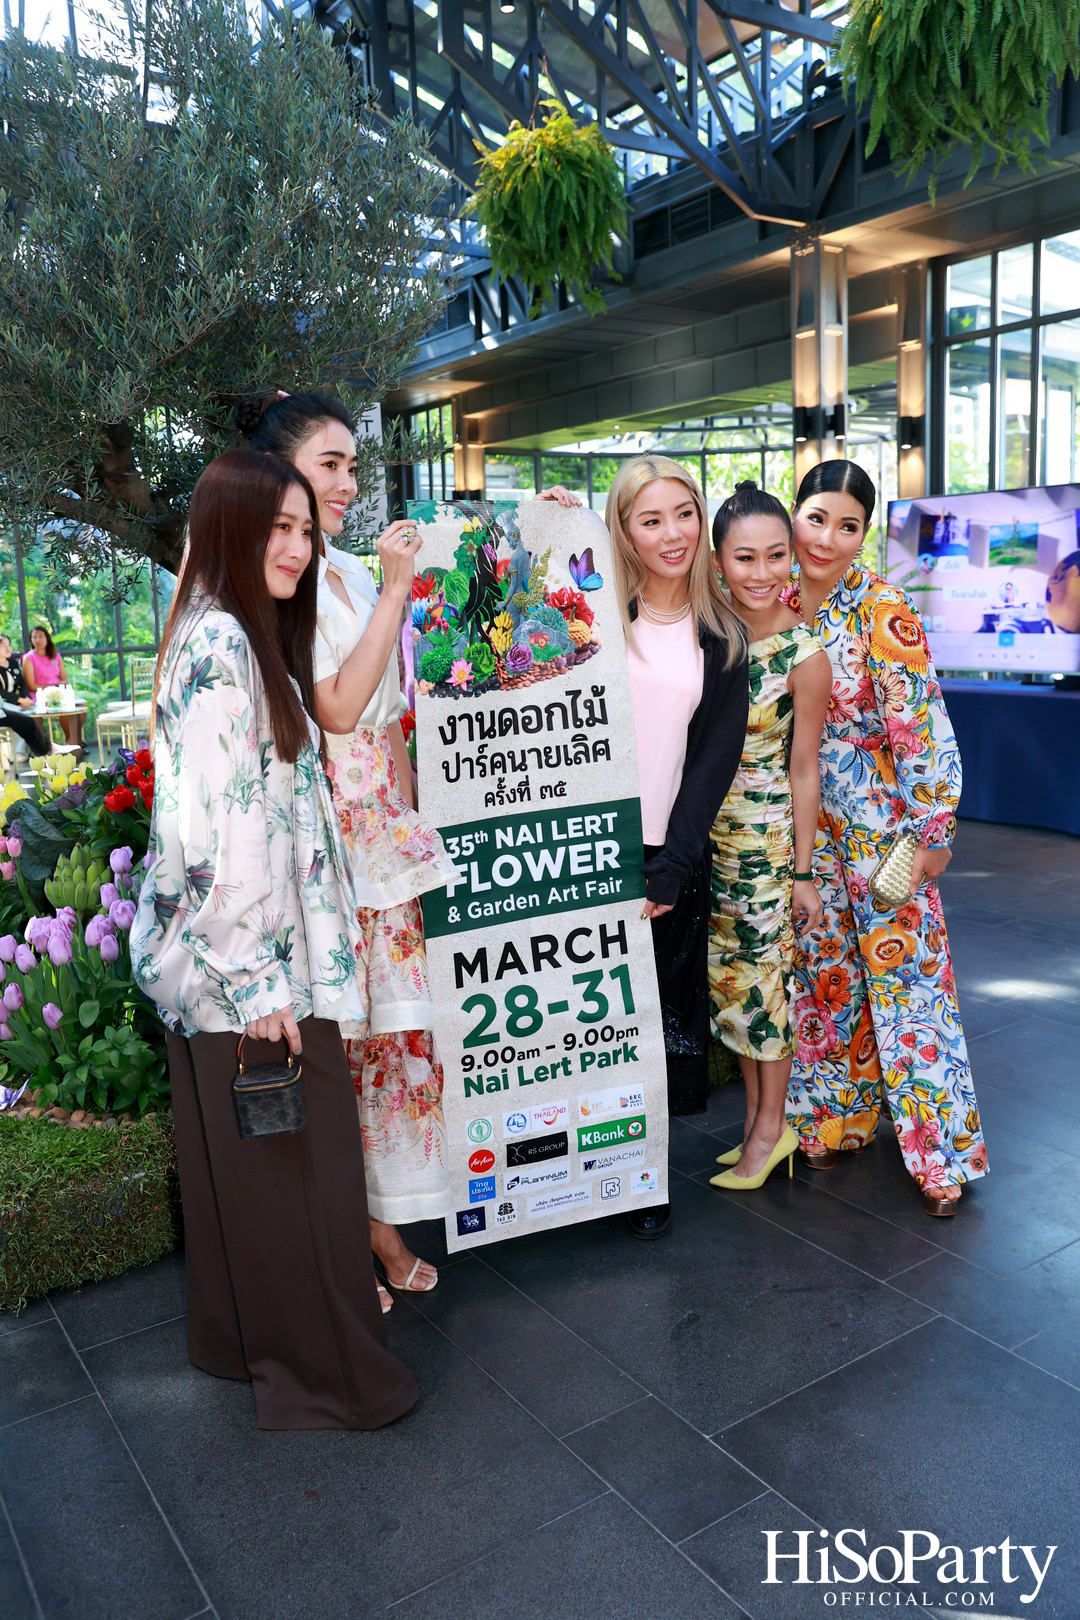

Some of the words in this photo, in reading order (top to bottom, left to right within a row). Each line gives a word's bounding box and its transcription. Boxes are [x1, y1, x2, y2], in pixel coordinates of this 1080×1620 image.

[438, 684, 609, 746] งานดอกไม้
[441, 733, 612, 783] ปาร์คนายเลิศ
[484, 775, 531, 808] ครั้งที่
[539, 780, 568, 800] ๓๕
[446, 830, 489, 860] 35th
[495, 822, 544, 849] NAI
[551, 811, 619, 841] LERT
[447, 905, 462, 924] &
[467, 891, 540, 919] Garden
[547, 884, 580, 905] Art
[585, 877, 623, 898] Fair
[453, 919, 629, 989] MARCH
[460, 963, 636, 1050] 28-31
[460, 1046, 541, 1073] 9.00am
[563, 1025, 639, 1052] 9.00pm
[463, 1068, 510, 1098] Nai
[517, 1056, 573, 1087] Lert
[579, 1042, 640, 1073] Park
[533, 1107, 567, 1119] THAILAND
[581, 1125, 625, 1147] KBank
[528, 1147, 538, 1155] RS
[538, 1141, 566, 1153] GROUP
[597, 1149, 644, 1165] VANACHAI
[520, 1170, 568, 1185] PLATINUM
